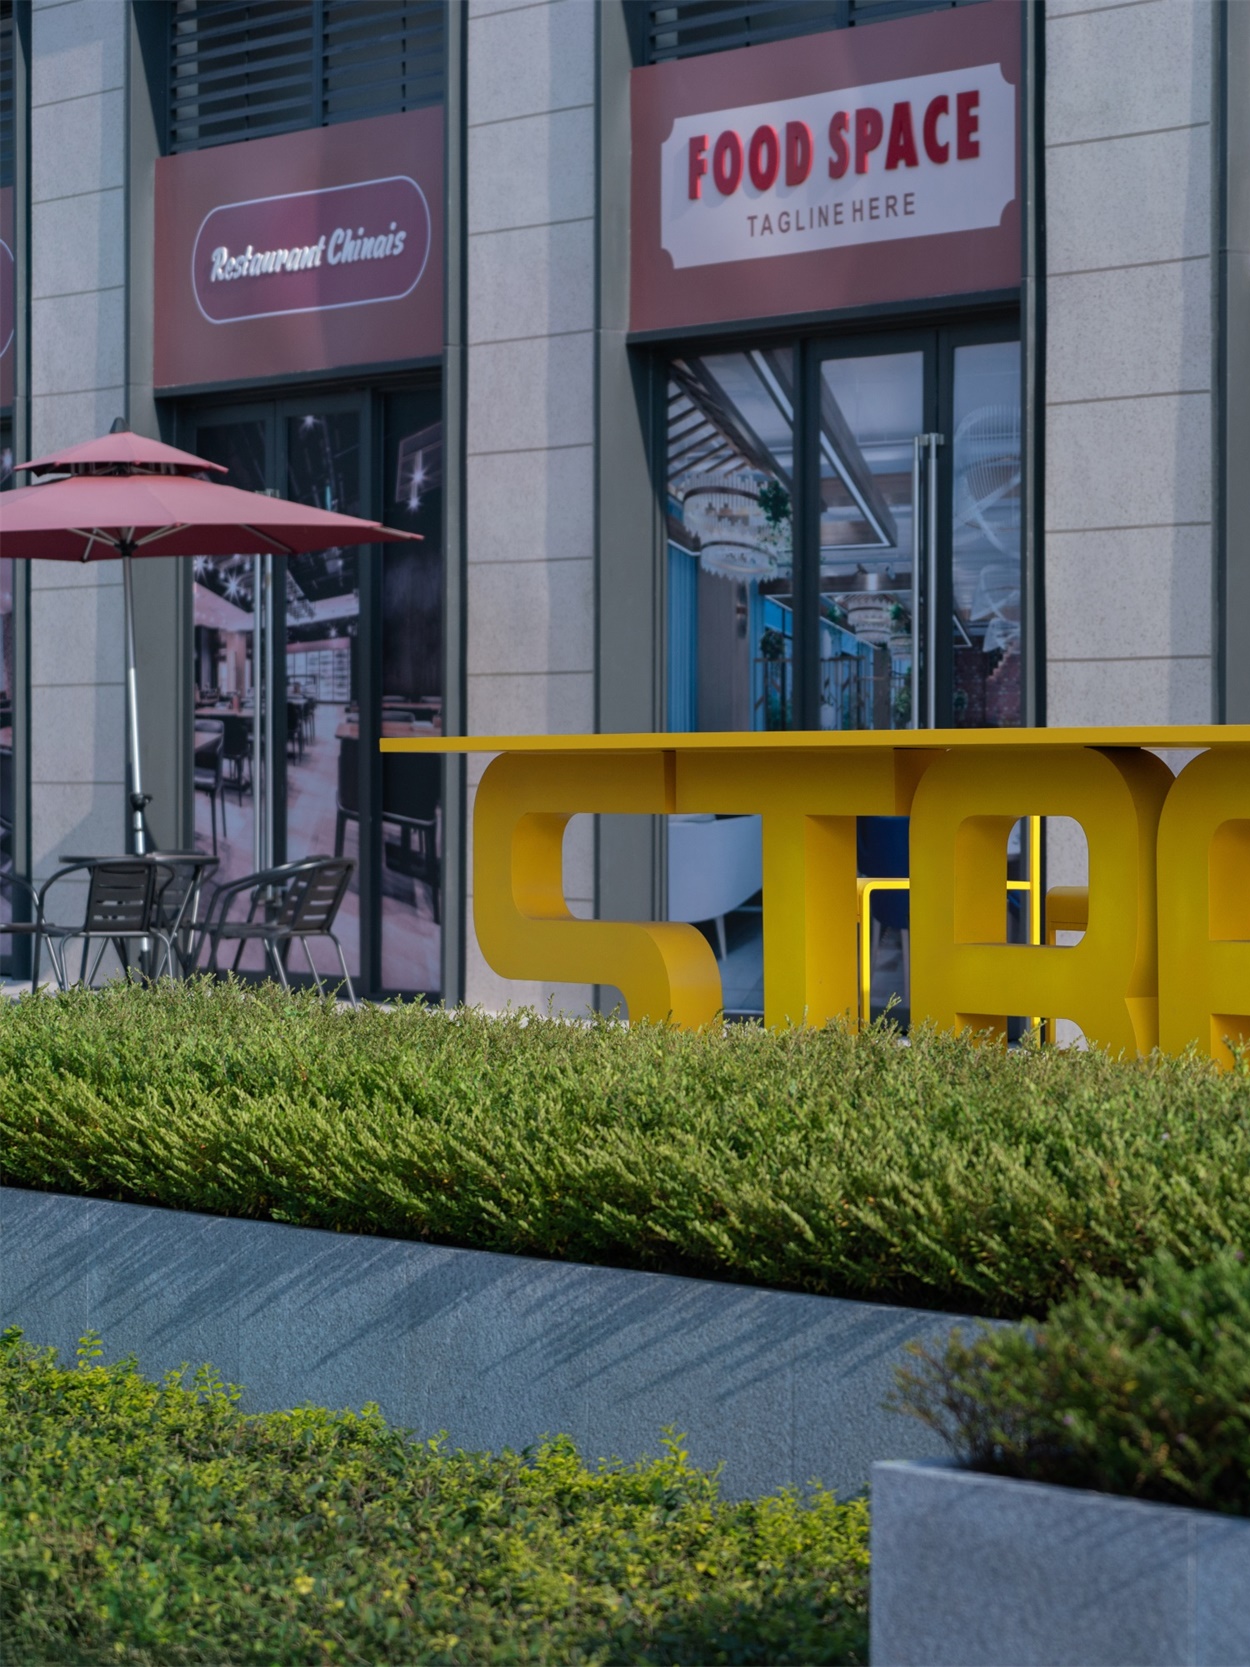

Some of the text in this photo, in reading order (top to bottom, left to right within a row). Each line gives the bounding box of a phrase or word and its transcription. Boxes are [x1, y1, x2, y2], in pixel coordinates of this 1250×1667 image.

[688, 89, 980, 201] FOOD SPACE
[747, 192, 916, 238] TAGLINE HERE
[210, 221, 406, 283] Restaurant Chinais
